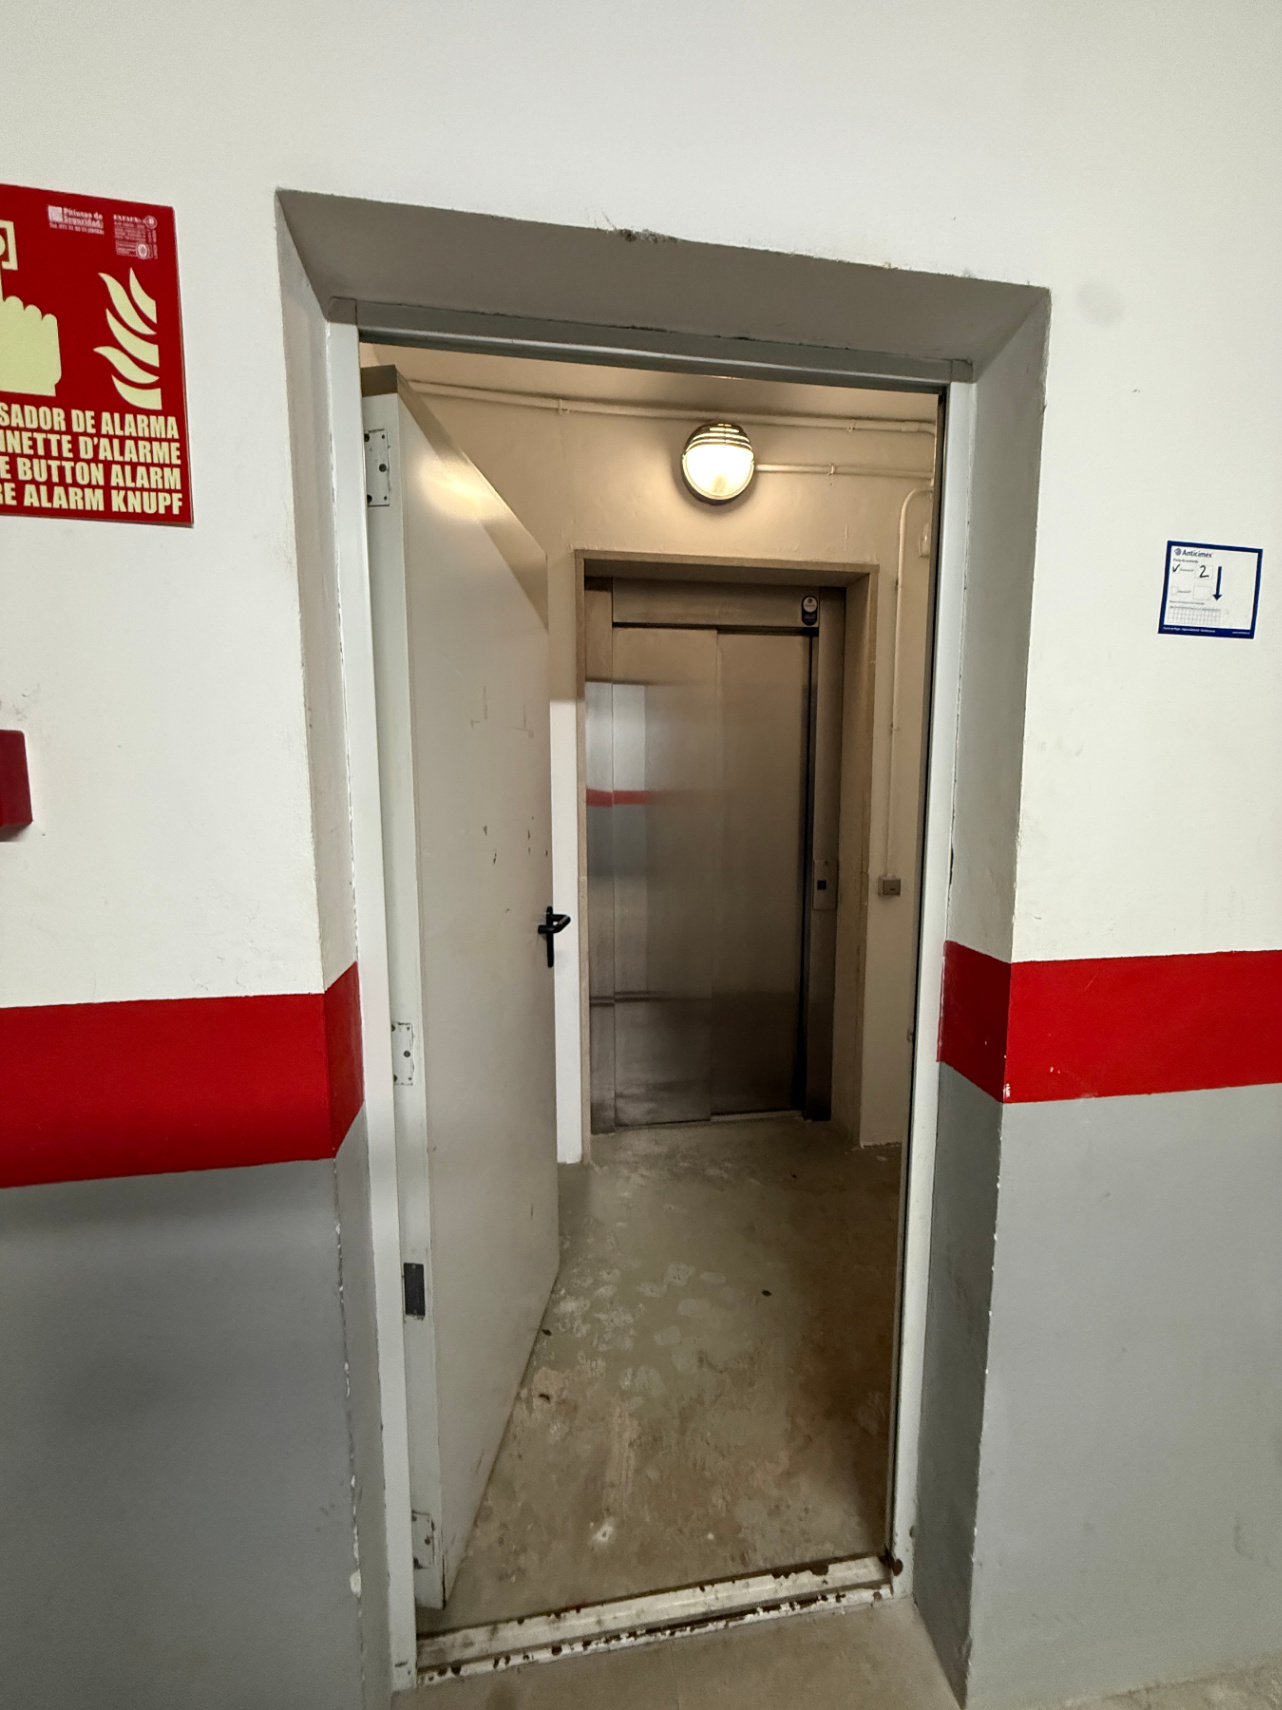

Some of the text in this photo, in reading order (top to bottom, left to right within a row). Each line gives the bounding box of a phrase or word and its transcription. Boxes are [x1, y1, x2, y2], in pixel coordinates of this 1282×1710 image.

[0, 402, 179, 439] SADOR DE ALARMA
[78, 435, 182, 464] D'ALARME
[16, 457, 105, 486] BUTTON
[110, 464, 182, 490] ALARM
[0, 482, 183, 515] E ALARM KNUPF
[1182, 549, 1212, 558] Anticimex
[1199, 564, 1210, 578] 2
